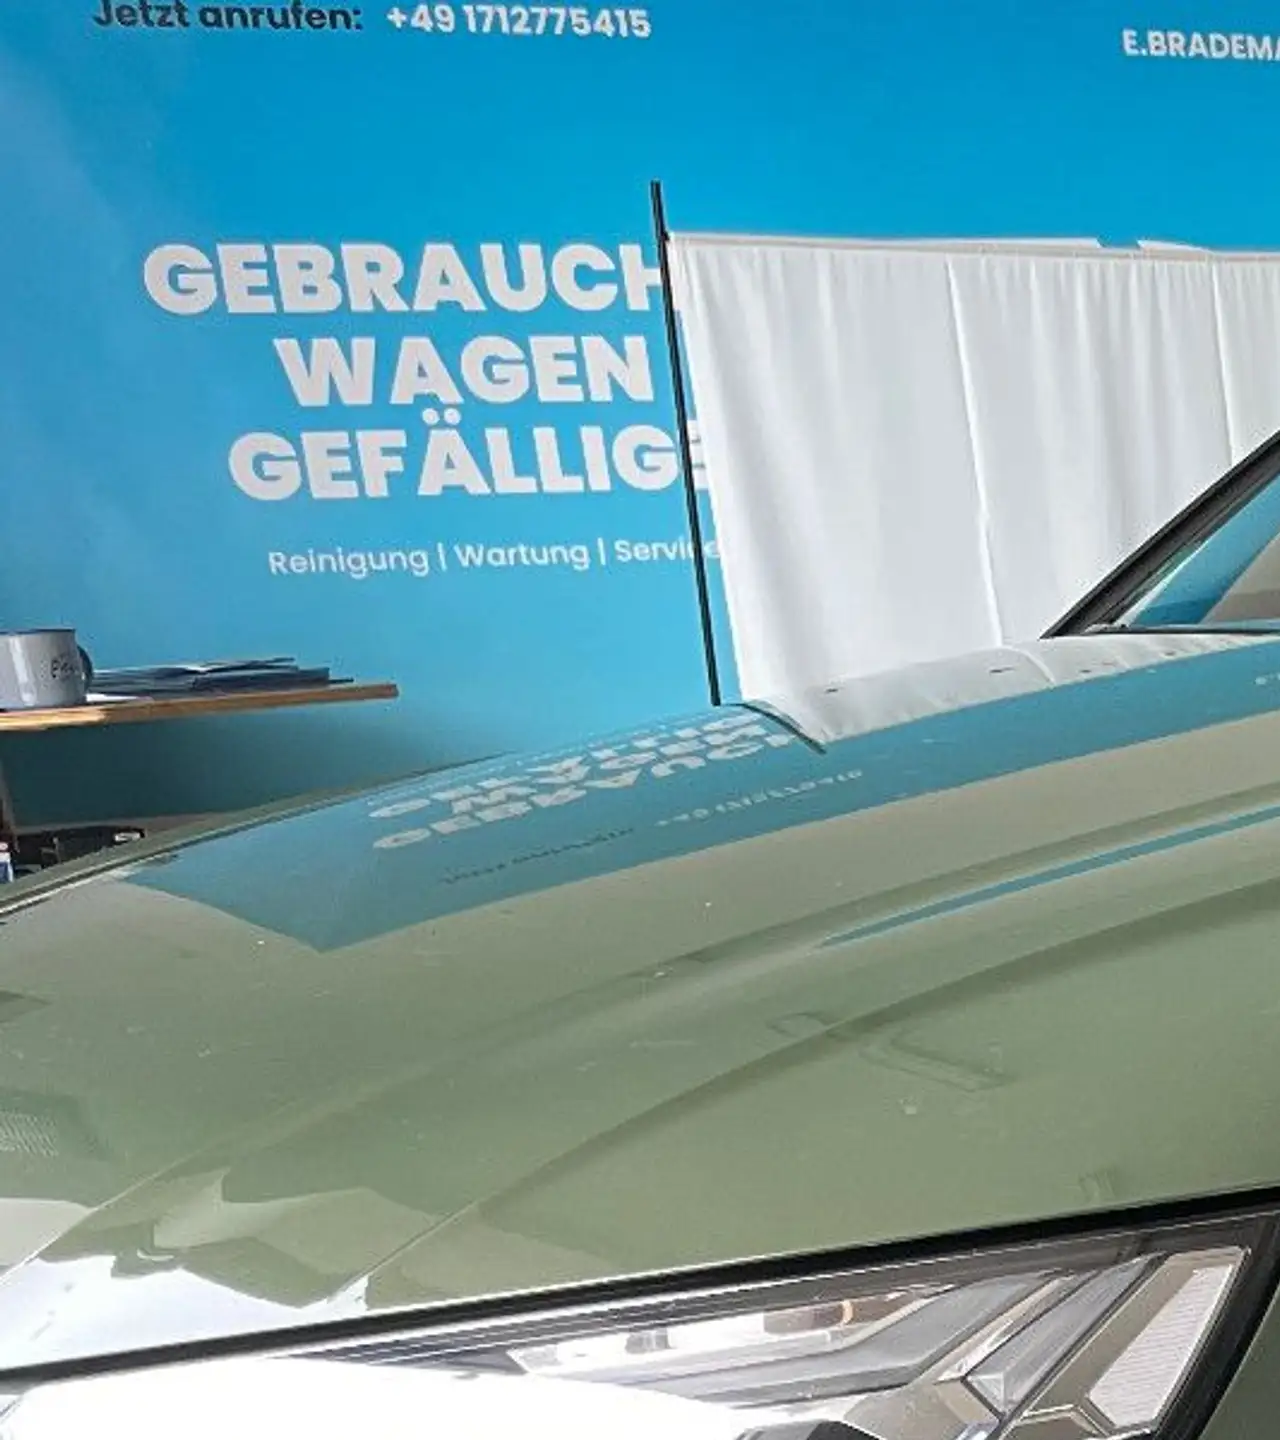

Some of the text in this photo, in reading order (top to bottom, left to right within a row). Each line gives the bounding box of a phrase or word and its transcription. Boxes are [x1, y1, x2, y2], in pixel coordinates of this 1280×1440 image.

[93, 0, 651, 38] Jetzt anrufen: +49 1712775415
[273, 335, 655, 406] WAGEN
[268, 541, 430, 580] Reinigung
[454, 540, 590, 571] Wartung
